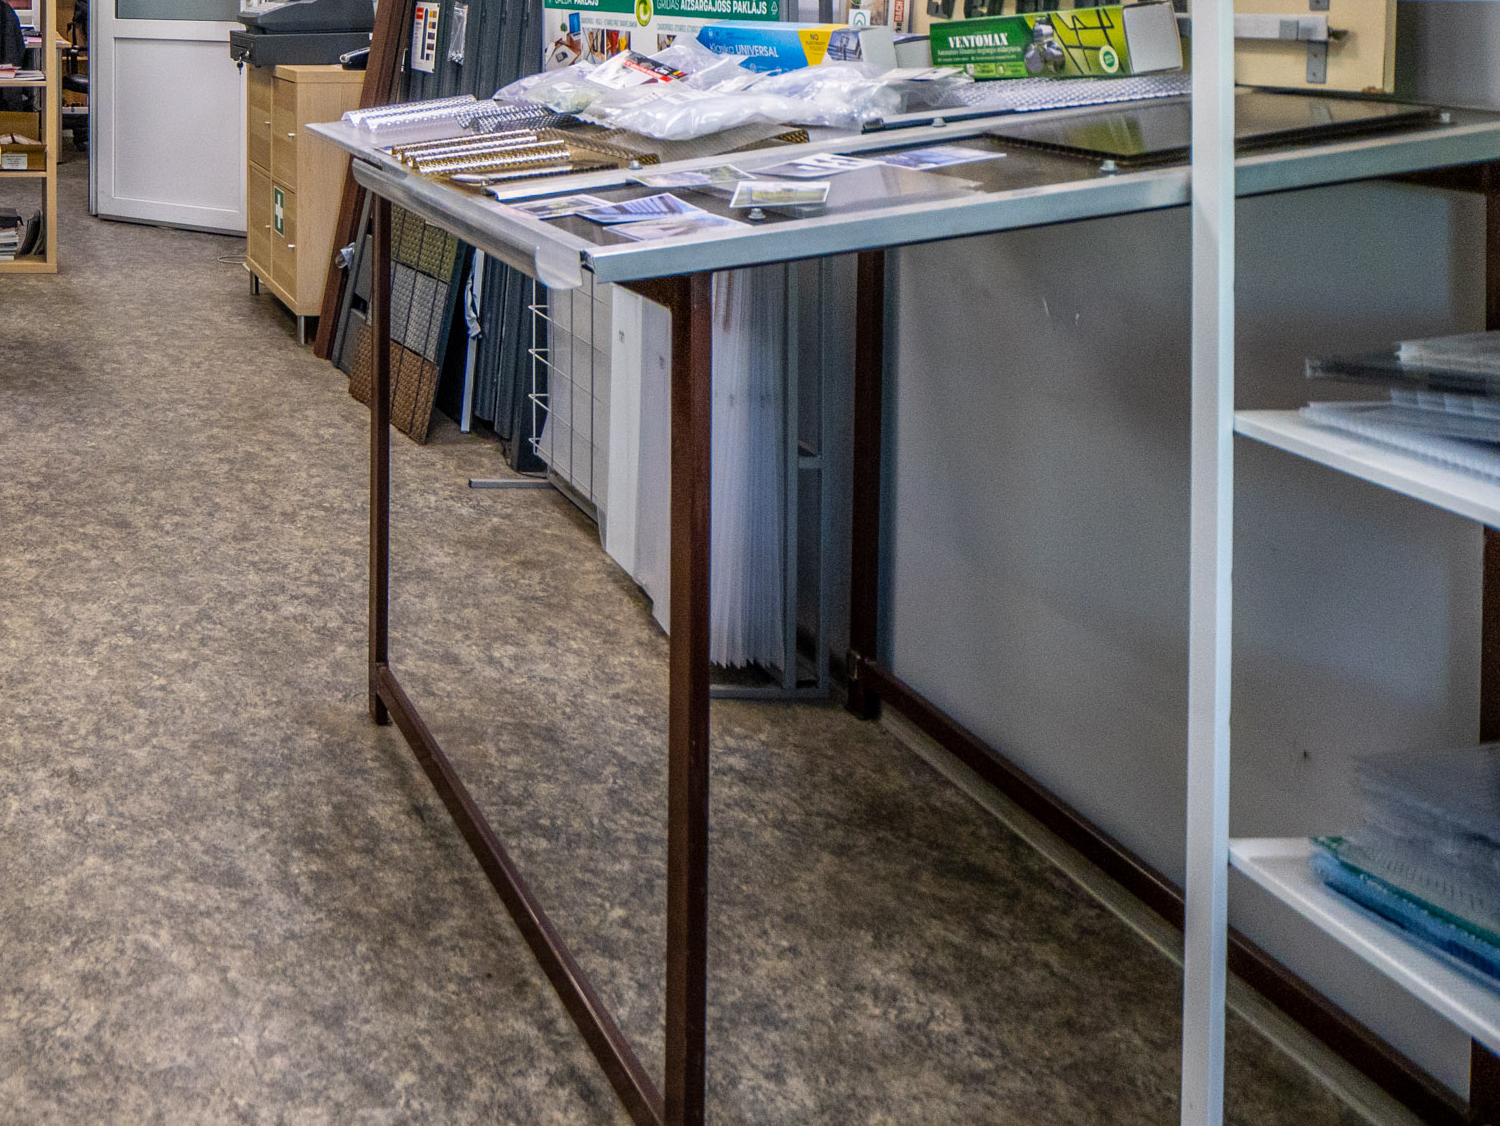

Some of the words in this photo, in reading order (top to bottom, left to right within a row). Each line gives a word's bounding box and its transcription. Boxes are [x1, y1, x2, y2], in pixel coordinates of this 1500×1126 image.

[732, 0, 768, 15] PAKLĀJS
[948, 32, 1008, 49] VENTOMAX
[736, 44, 779, 58] UNIVERSAL
